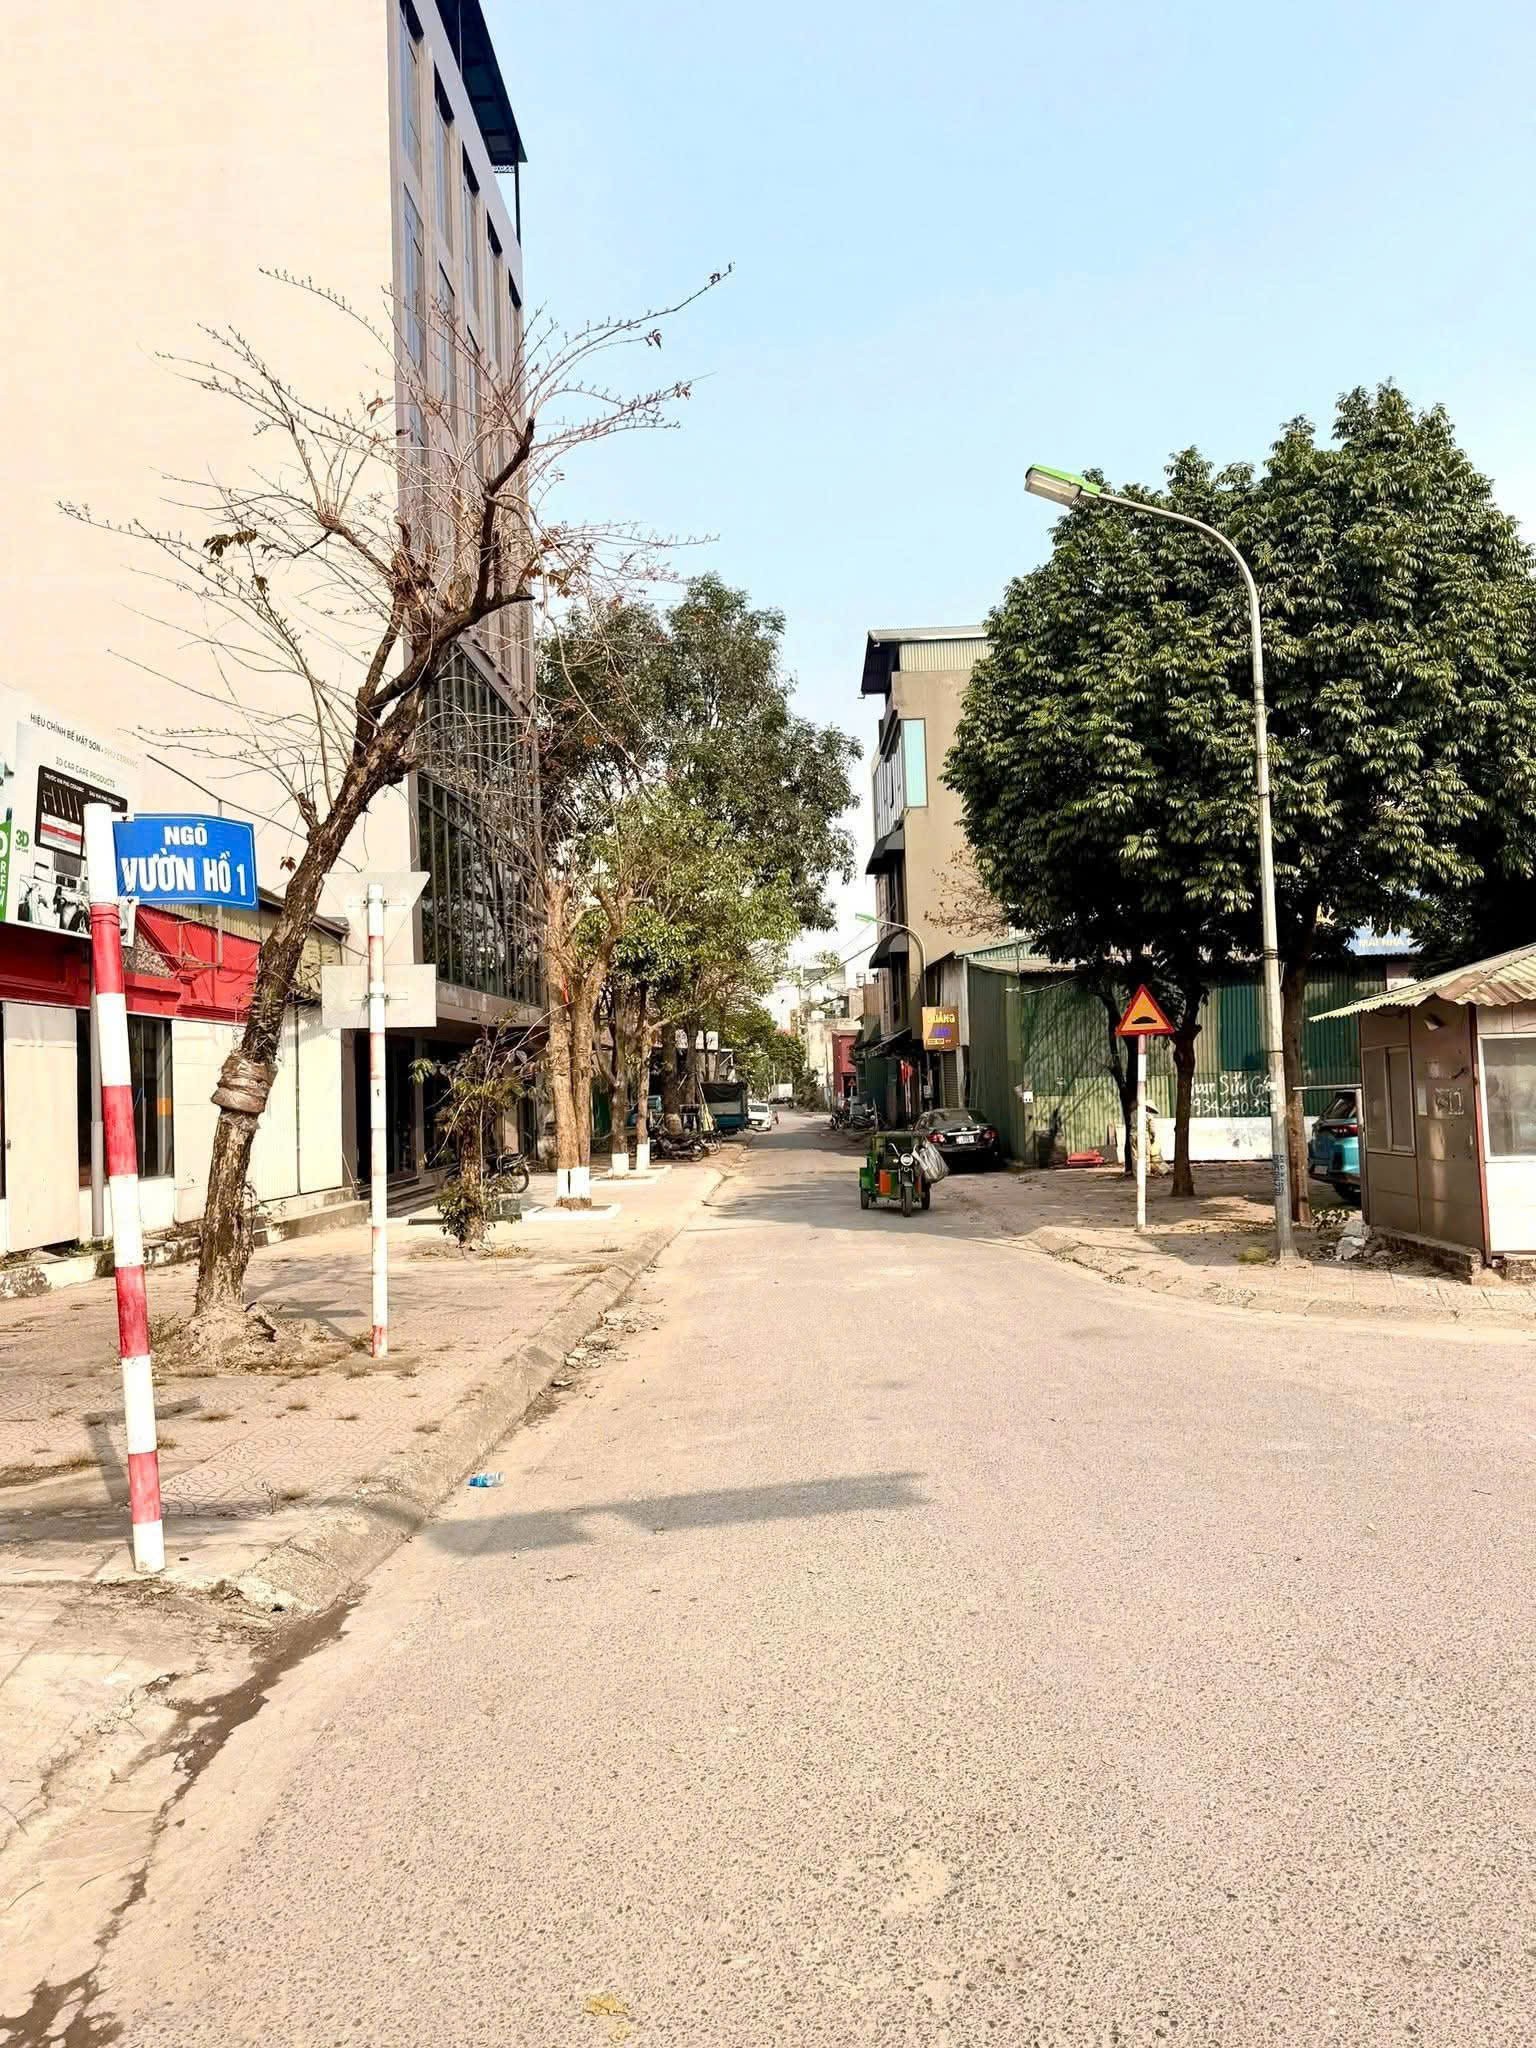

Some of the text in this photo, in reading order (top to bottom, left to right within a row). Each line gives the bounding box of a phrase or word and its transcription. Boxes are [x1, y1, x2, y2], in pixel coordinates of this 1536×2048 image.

[164, 823, 208, 846] NGÕ
[121, 848, 247, 896] VƯỜN HỒ 1
